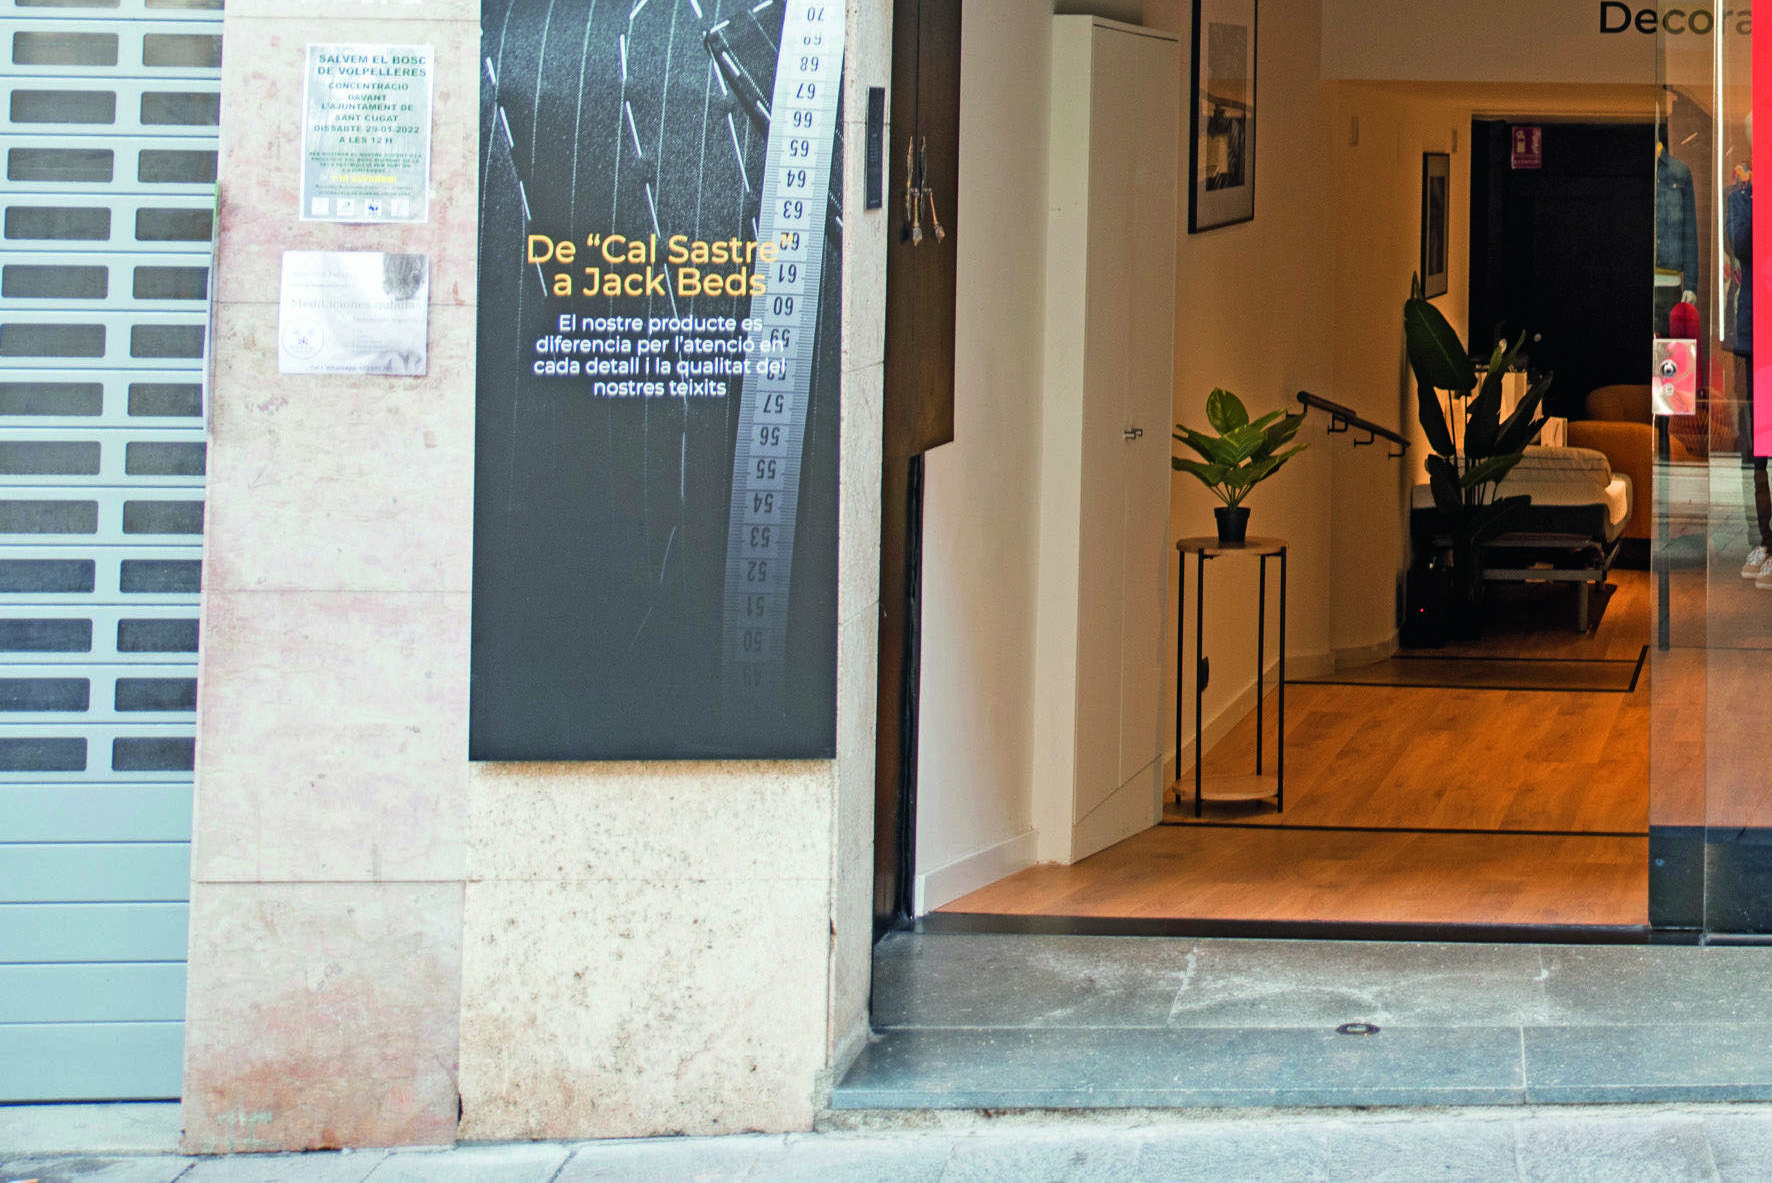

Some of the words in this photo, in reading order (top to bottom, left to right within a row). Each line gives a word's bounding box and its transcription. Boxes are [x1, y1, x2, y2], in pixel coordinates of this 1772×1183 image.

[319, 54, 368, 64] SALVEM
[373, 55, 387, 64] EL
[392, 55, 427, 65] BOSC
[317, 66, 334, 75] DE
[339, 67, 427, 77] VOLPELLERES
[796, 81, 816, 100] 67
[335, 114, 361, 122] SANT
[364, 114, 399, 122] CUGAT
[793, 111, 812, 128] 66
[348, 136, 367, 144] LES
[790, 139, 809, 157] 65
[787, 169, 806, 188] 64
[783, 200, 803, 219] 63
[527, 234, 576, 264] De
[553, 277, 572, 297] a
[582, 266, 666, 297] Jack
[677, 266, 767, 297] Beds
[778, 264, 797, 283] 61
[559, 314, 577, 332] El
[582, 316, 643, 333] nostre
[647, 314, 736, 338] producte
[741, 318, 764, 333] es
[535, 335, 632, 354] diferencia
[637, 338, 669, 359] per
[760, 339, 785, 354] en
[533, 356, 581, 375] cada
[585, 356, 640, 375] detall
[644, 356, 650, 375] i
[655, 356, 671, 375] la
[676, 356, 751, 380] qualitat
[756, 356, 787, 375] del
[592, 380, 664, 397] nostres
[669, 378, 727, 397] teixits
[763, 394, 785, 413] 57
[756, 459, 776, 479] 55
[753, 493, 774, 513] 54
